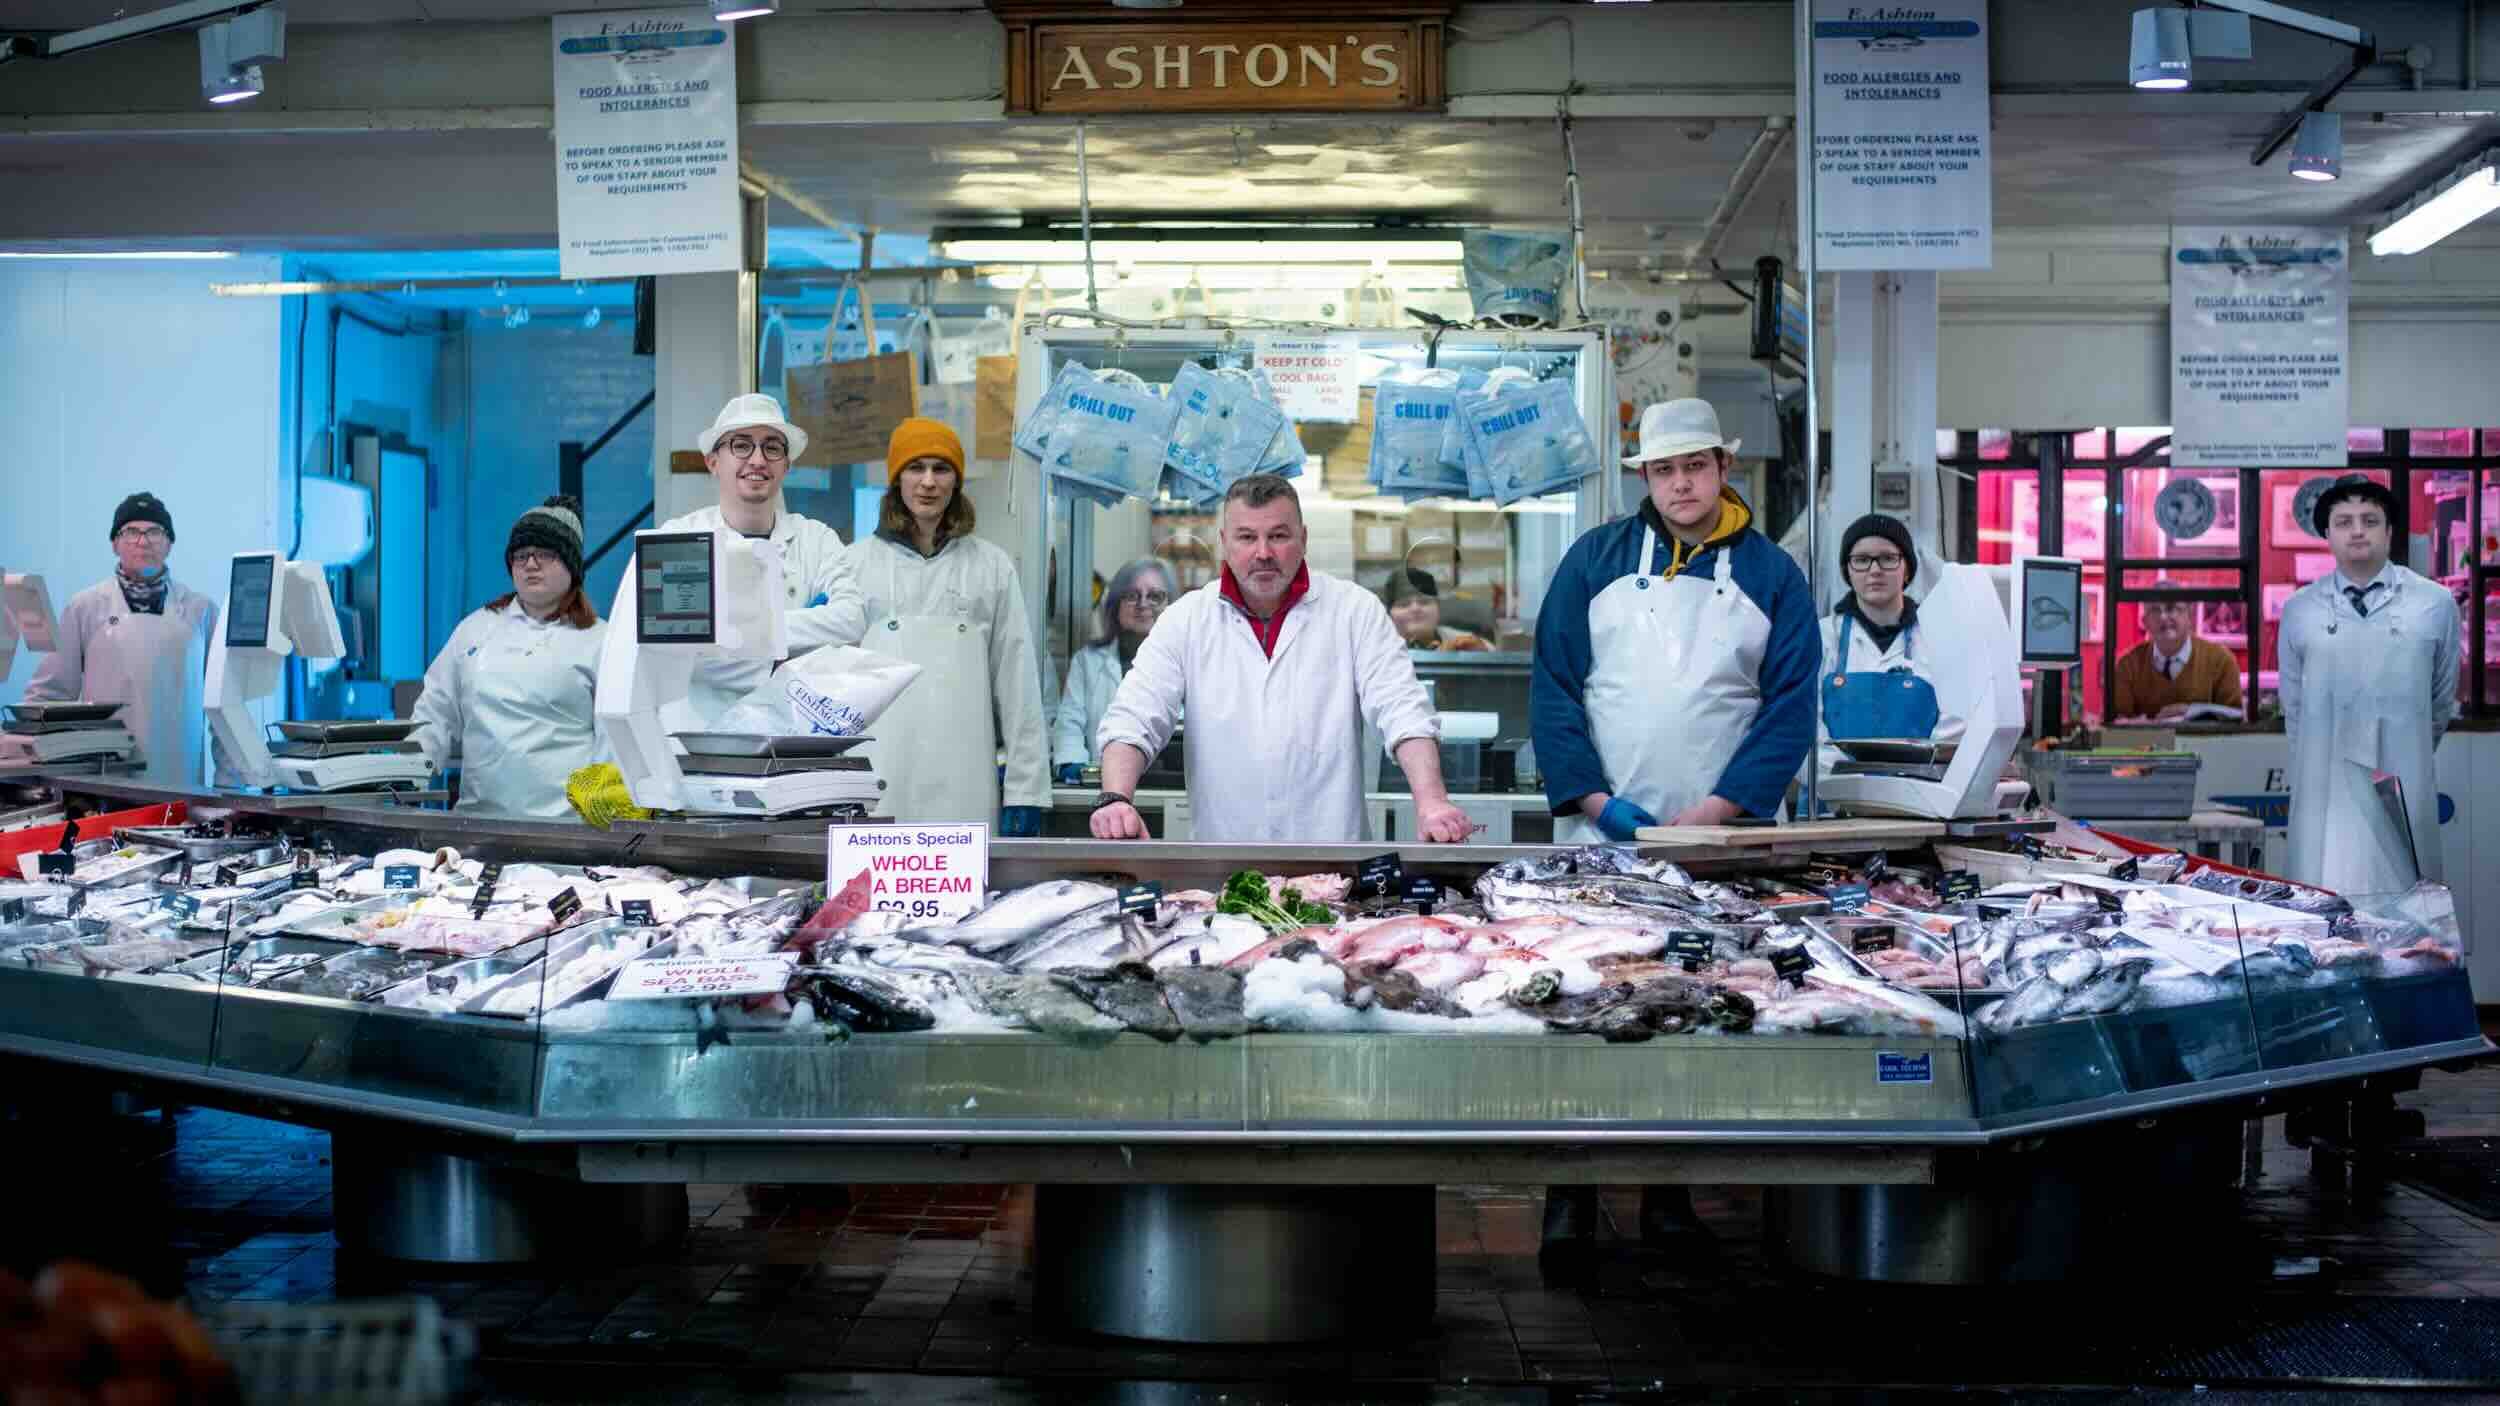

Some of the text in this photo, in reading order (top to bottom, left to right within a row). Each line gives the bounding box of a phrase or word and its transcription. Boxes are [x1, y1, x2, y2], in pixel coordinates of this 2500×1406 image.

[1871, 7, 1935, 20] Ashton
[623, 19, 685, 33] Ashton
[1052, 34, 1400, 91] ASHTON'S
[1823, 72, 1961, 84] FOOD ALLERGIES AND
[579, 86, 611, 99] FOOD
[684, 79, 710, 92] AND
[1844, 87, 1941, 100] INTOLERANCES
[600, 96, 690, 113] INTOLERANCES
[1816, 135, 1979, 145] EFORE ORDERING PLEASE ASK
[567, 140, 726, 158] BEFORE ORDERING PLEASE ASK
[1825, 149, 1859, 158] SPEAK
[1863, 149, 1878, 158] TO
[1880, 149, 1889, 157] A
[1892, 148, 1934, 158] SENIOR
[1936, 148, 1981, 157] MEMBER
[566, 153, 729, 171] TO SPEAK TO A SENIOR MEMBER
[1819, 162, 1969, 172] OF OUR STAFF ABOUT YOUR
[576, 167, 717, 184] OF OUR STAFF ABOUT YOUR
[1852, 175, 1937, 186] REQUIREMENTS
[607, 181, 688, 196] REQUIREMENTS
[2215, 311, 2305, 322] INTOLERANCES
[2180, 354, 2339, 364] BEFORE ORDERING PLEASE ASK
[2179, 367, 2192, 376] TO
[2195, 367, 2227, 376] SPEAK
[2231, 367, 2244, 376] TO
[2257, 367, 2295, 376] SENIOR
[2298, 367, 2341, 376] MEMBER
[2190, 380, 2329, 389] OF OUR STAFF ABOUT YOUR
[2219, 392, 2300, 404] REQUIREMENTS
[1068, 392, 1136, 424] CHILL OUT
[1394, 402, 1431, 419] CHILL
[1481, 403, 1542, 436] CHILL OUT
[848, 831, 972, 847] Ashton's Special
[872, 855, 948, 871] WHOLE
[895, 877, 972, 894] BREAM
[665, 966, 748, 976] WHOLE
[640, 974, 760, 987] SEA BASS
